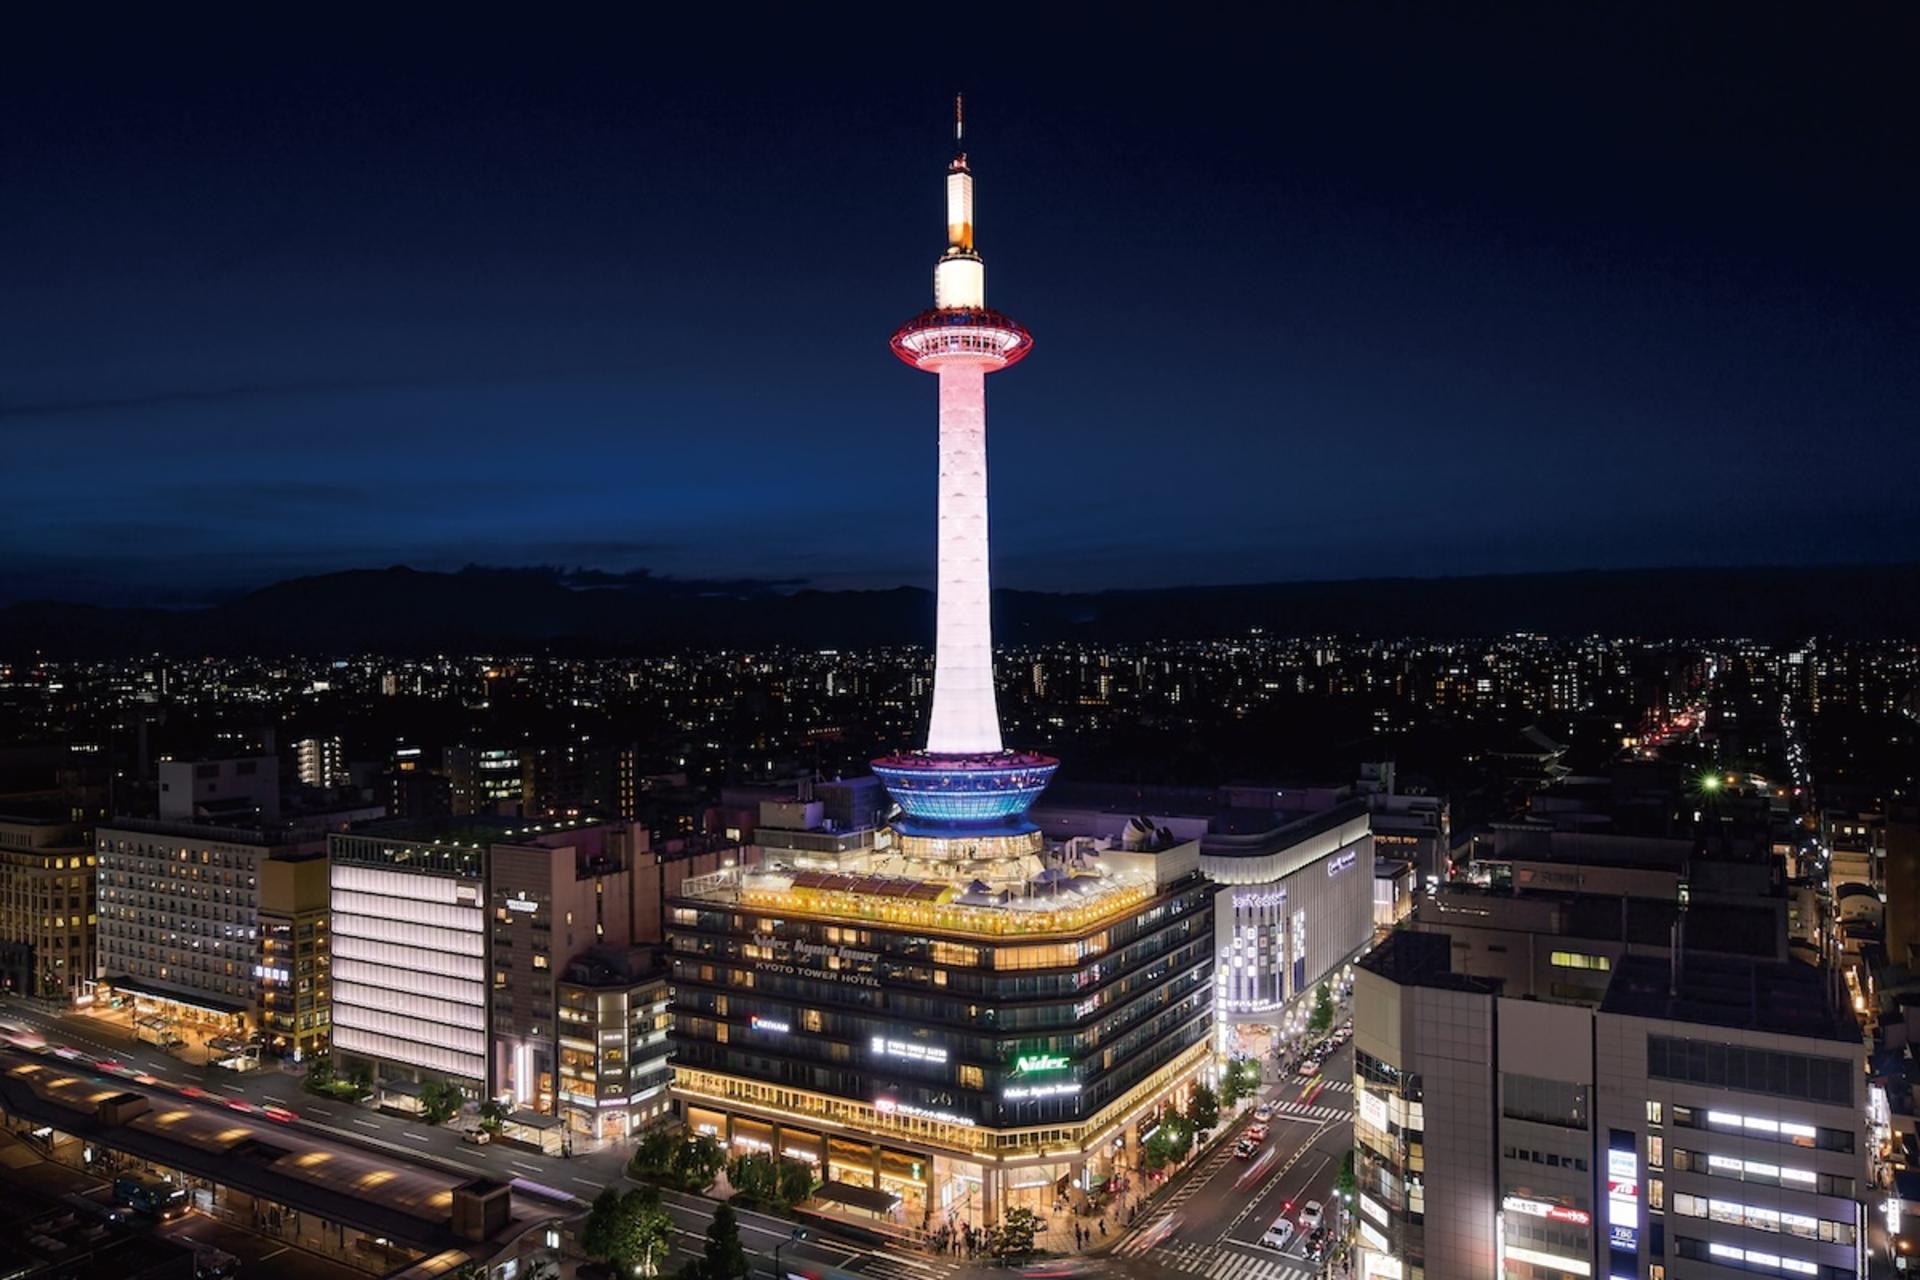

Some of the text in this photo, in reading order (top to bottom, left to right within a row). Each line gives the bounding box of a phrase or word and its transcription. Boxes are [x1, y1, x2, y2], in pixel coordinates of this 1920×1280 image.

[752, 934, 880, 962] Nidec Kyoto Tower
[756, 961, 881, 987] KYOTO TOWER HOTEL
[1014, 1054, 1071, 1073] Nidec
[1003, 1083, 1083, 1099] Nidec Kyoto Tower
